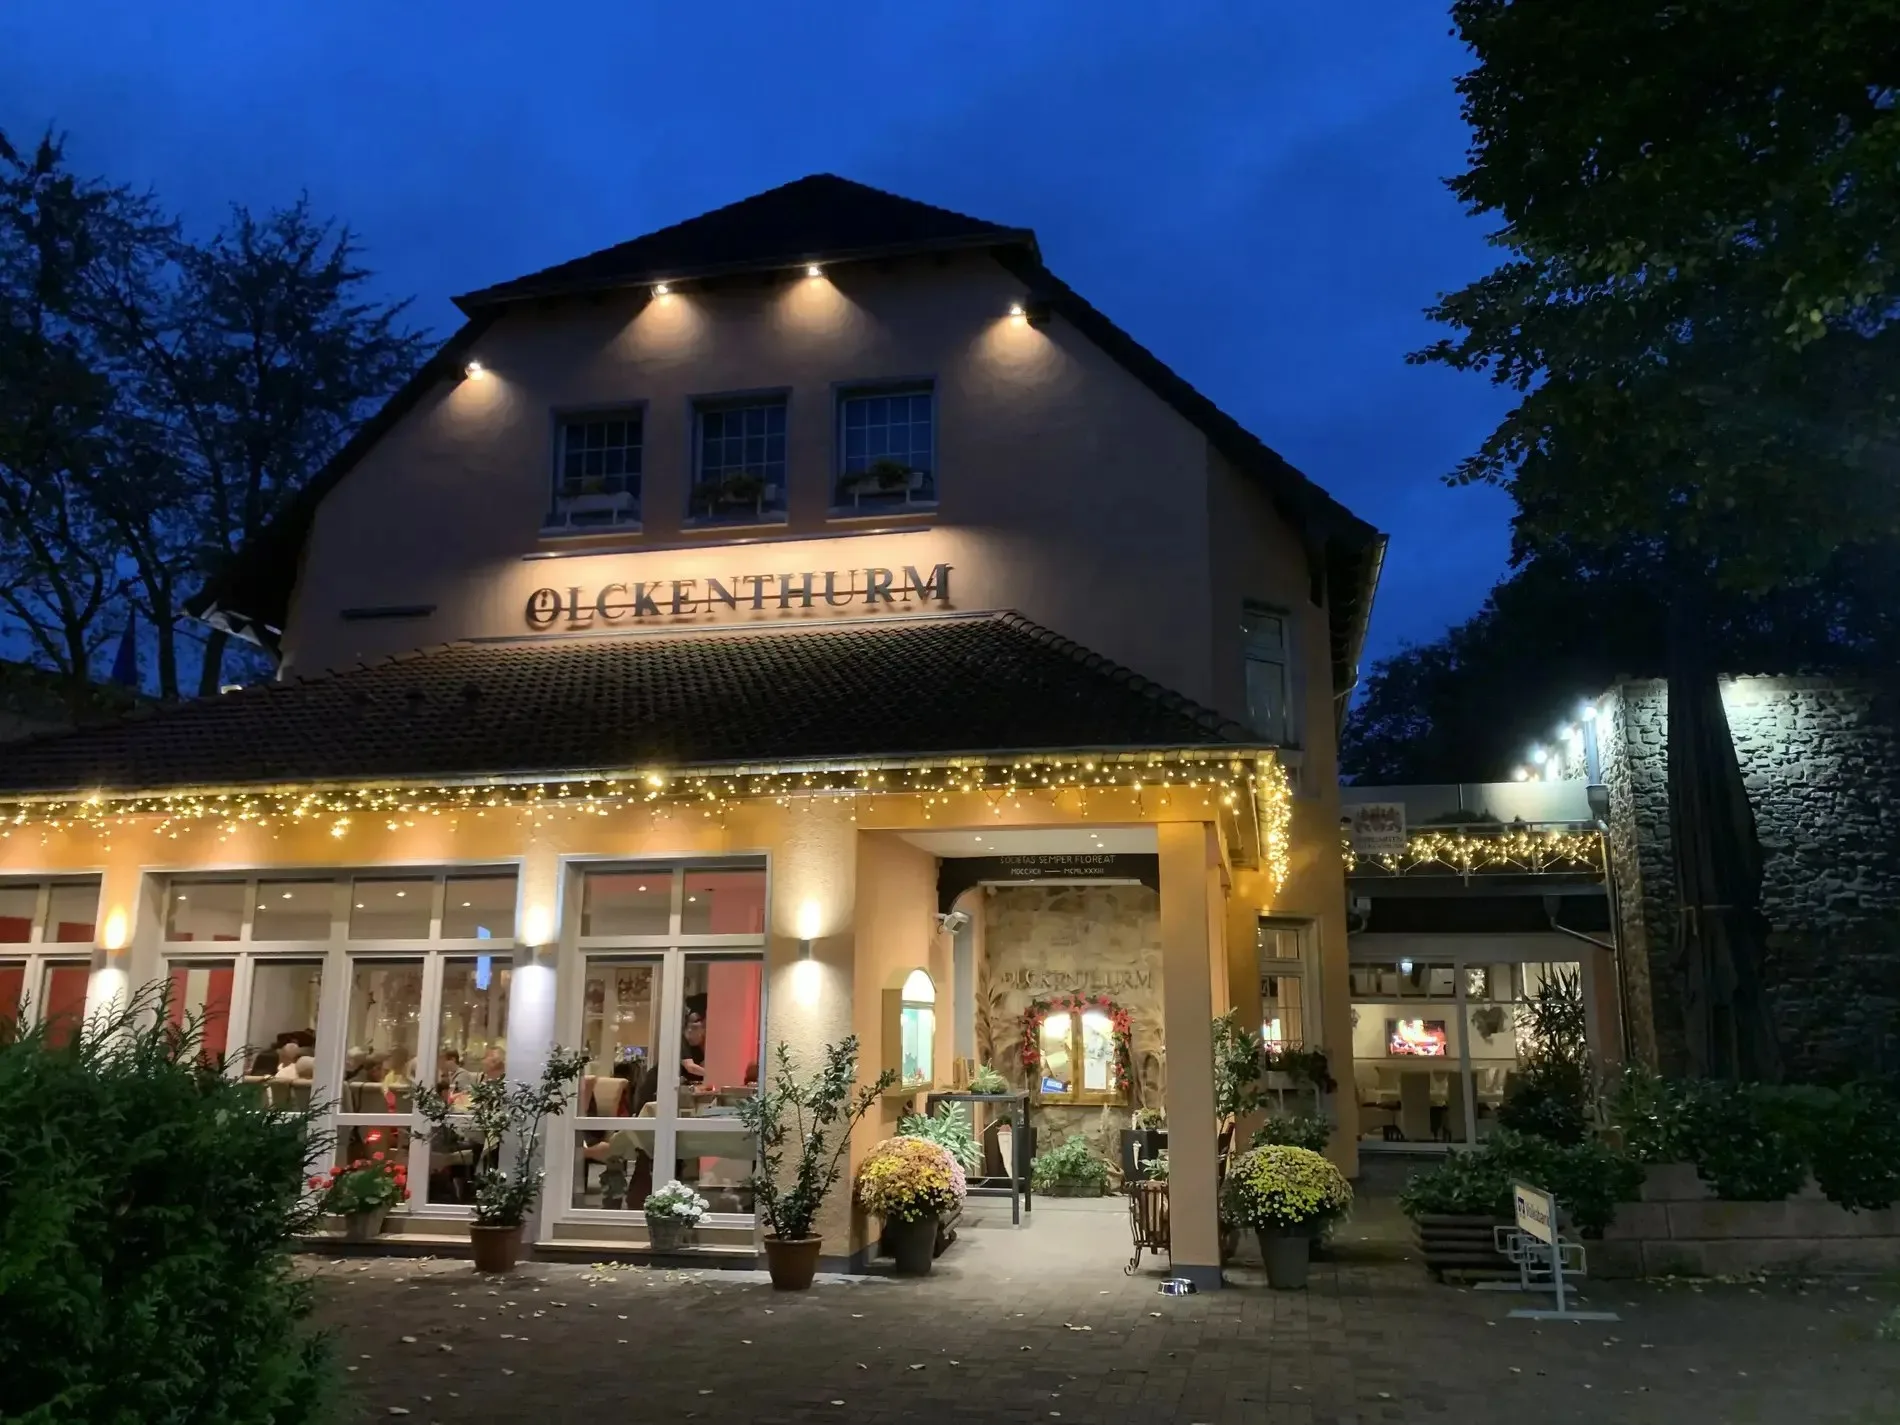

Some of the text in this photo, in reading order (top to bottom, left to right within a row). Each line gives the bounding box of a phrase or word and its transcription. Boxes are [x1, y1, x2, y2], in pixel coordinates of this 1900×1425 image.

[526, 562, 953, 623] OLCKENTHURM
[1039, 855, 1073, 864] SEMPER
[1075, 854, 1116, 864] FLOREAT
